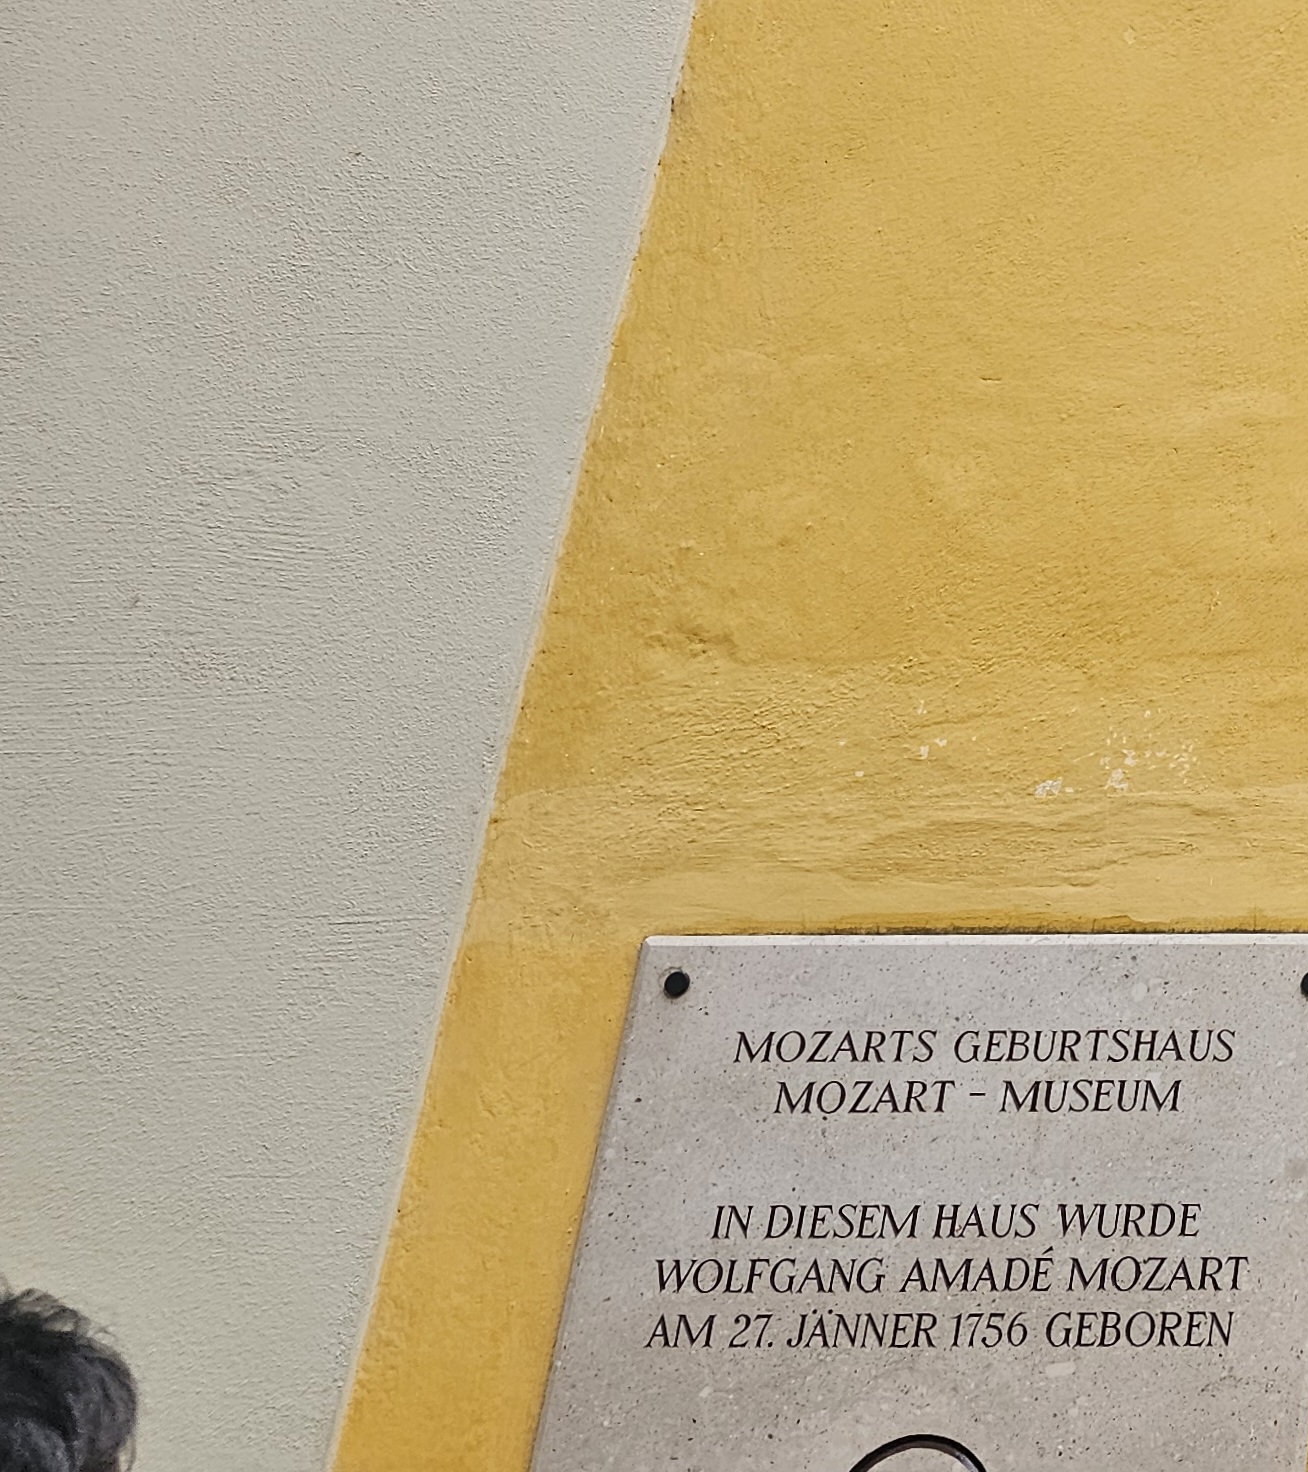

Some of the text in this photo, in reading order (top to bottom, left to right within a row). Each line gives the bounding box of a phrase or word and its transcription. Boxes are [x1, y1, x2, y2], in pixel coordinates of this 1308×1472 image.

[732, 1028, 1237, 1065] MOZARTS GEBURTSHAUS
[772, 1078, 957, 1116] MOZART
[998, 1078, 1183, 1115] MUSEUM
[710, 1202, 1203, 1241] IN DIESEM HAUS WURDE
[654, 1245, 1250, 1295] WOLFGANG AMADÉ MOZART
[642, 1307, 1236, 1351] AM 27. JÄNNER 1756 GEBOREN
